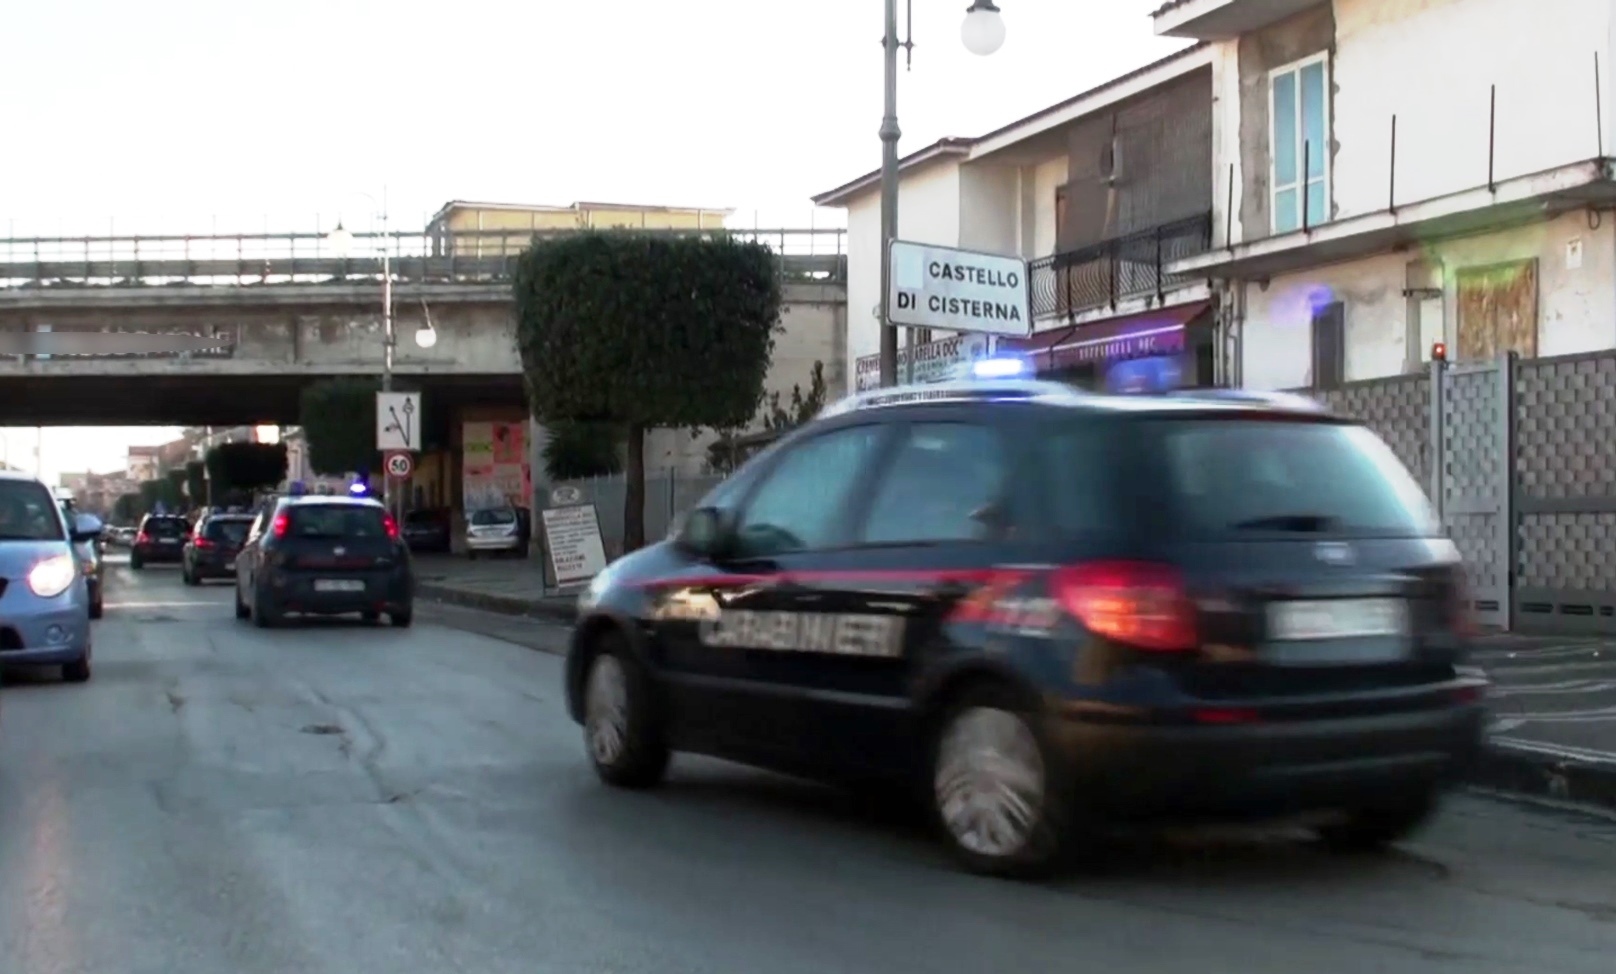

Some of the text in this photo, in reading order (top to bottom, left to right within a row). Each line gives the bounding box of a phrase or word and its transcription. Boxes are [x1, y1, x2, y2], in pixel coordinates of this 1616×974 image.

[929, 261, 1019, 289] CASTELLO
[897, 291, 1021, 322] DI CISTERNA
[391, 458, 408, 472] 50
